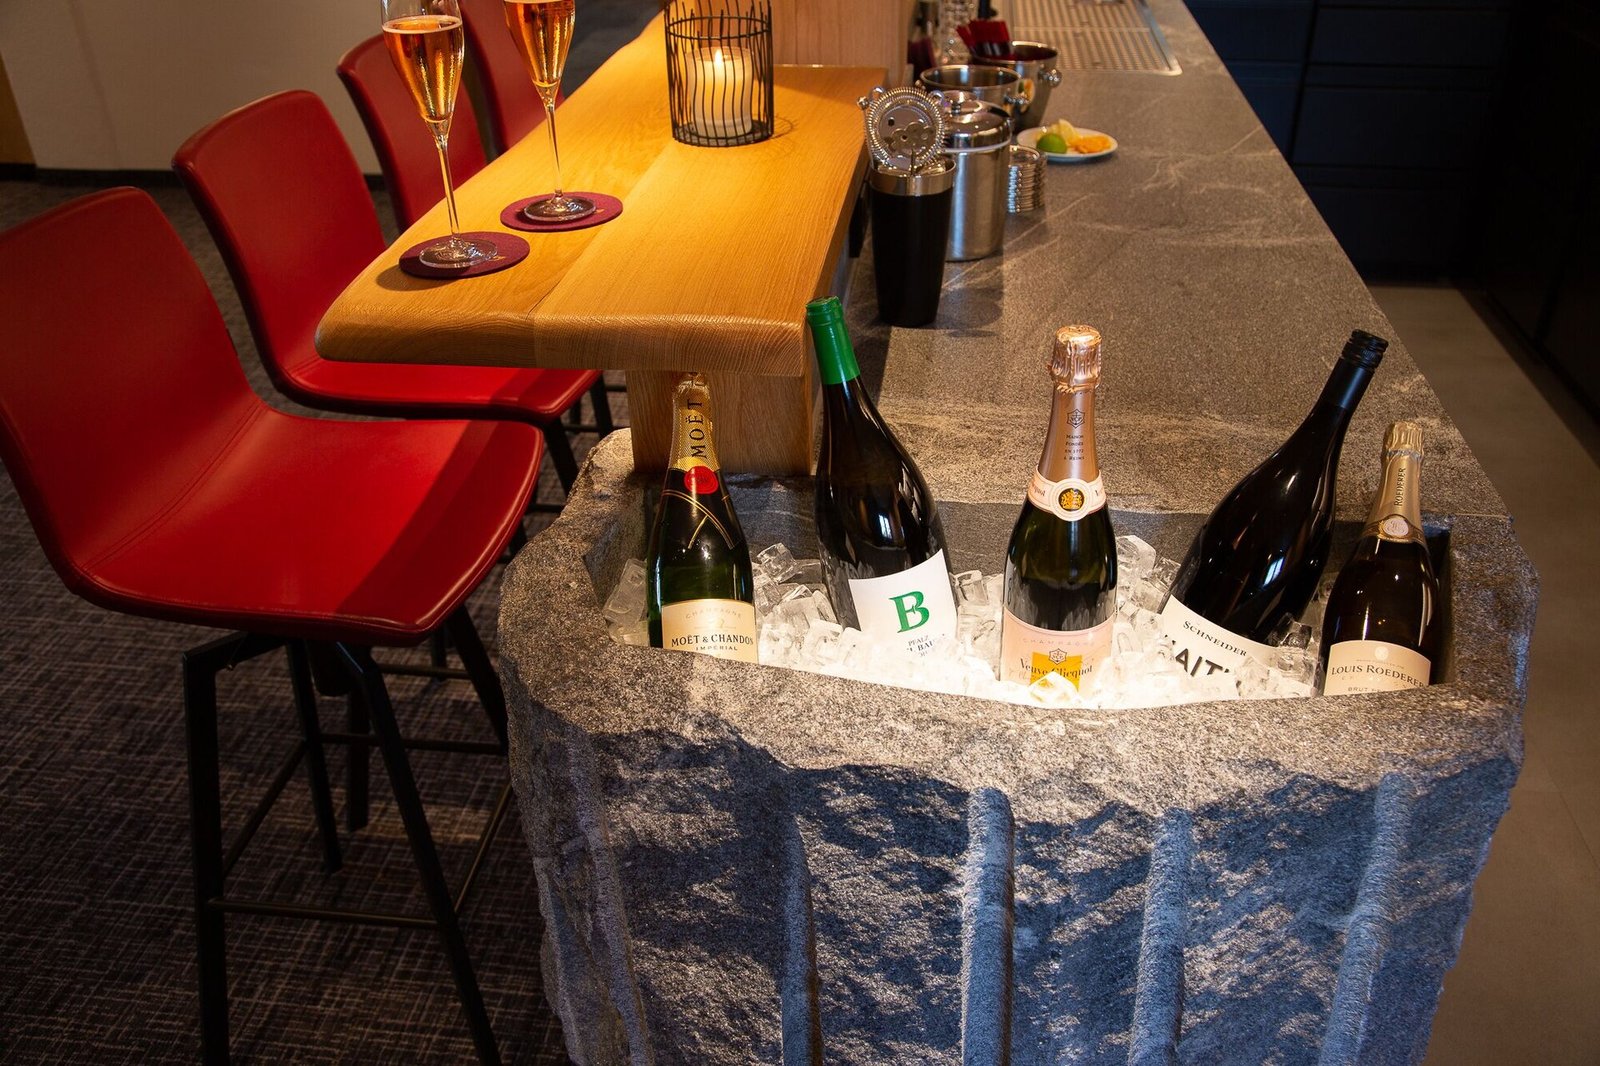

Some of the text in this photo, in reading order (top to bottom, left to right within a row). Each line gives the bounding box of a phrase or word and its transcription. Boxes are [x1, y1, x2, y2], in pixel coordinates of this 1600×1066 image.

[686, 399, 707, 458] MOËT
[1394, 467, 1406, 507] ROEDERER
[888, 590, 930, 633] B
[671, 634, 700, 647] MOËT
[711, 633, 754, 646] CHANDON
[1183, 620, 1247, 657] SCHNEIDER
[1020, 658, 1048, 676] Veuve
[1170, 640, 1230, 677] AIT
[1331, 664, 1363, 675] LOUIS
[1366, 664, 1426, 688] ROEDERER
